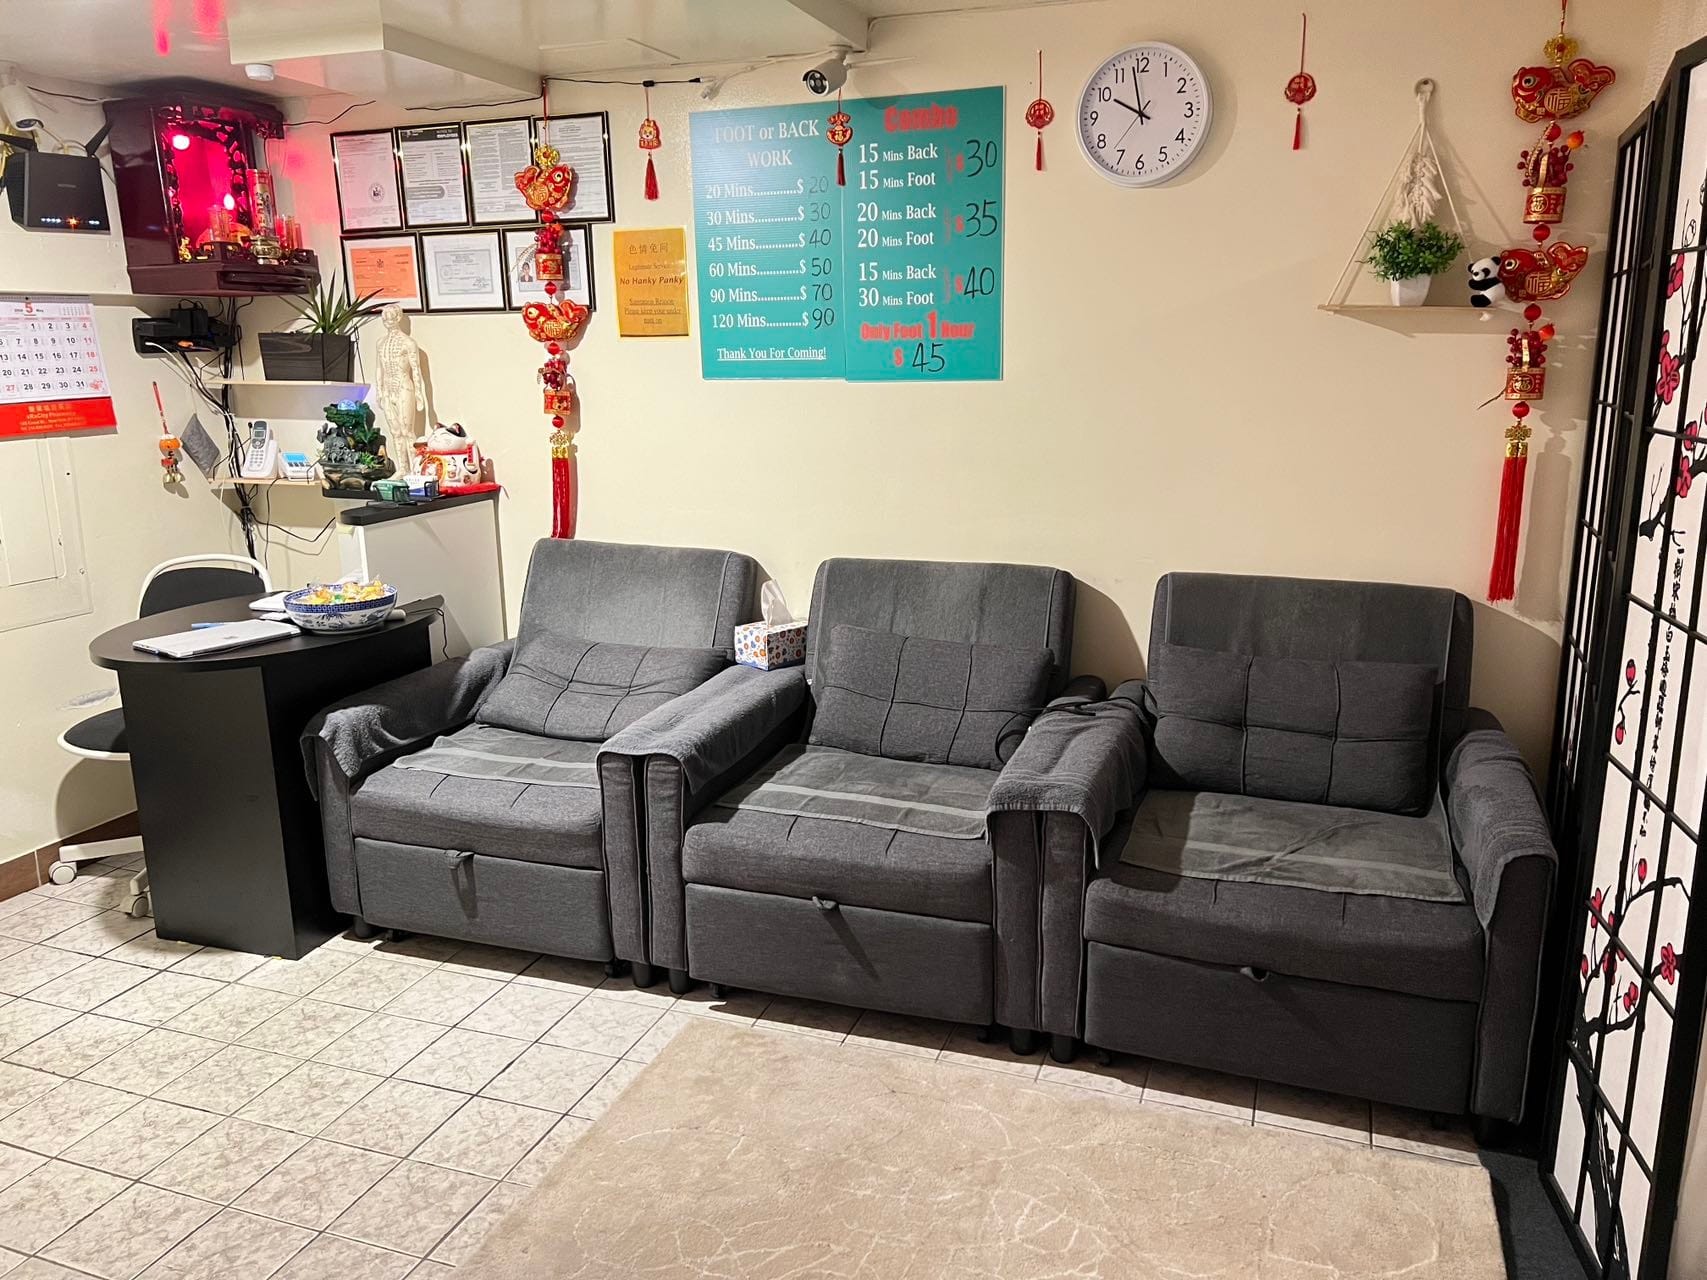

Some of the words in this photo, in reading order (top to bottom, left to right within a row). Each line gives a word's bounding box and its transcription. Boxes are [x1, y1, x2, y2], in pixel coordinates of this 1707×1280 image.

[1136, 57, 1150, 73] 12
[1163, 62, 1168, 77] 1
[1114, 67, 1125, 84] 11
[1176, 77, 1187, 93] 2
[1097, 86, 1112, 102] 10
[884, 103, 958, 133] Combo
[1090, 111, 1099, 126] 9
[1184, 102, 1194, 118] 3
[714, 125, 755, 143] FOOT
[760, 127, 774, 140] or
[779, 120, 819, 139] BACK
[1096, 133, 1107, 149] 8
[1174, 128, 1185, 143] 4
[747, 150, 793, 168] WORK
[859, 143, 878, 163] 15
[882, 151, 904, 162] Mins
[907, 143, 938, 160] Back
[966, 139, 998, 178] 30
[1116, 149, 1126, 165] 7
[1135, 154, 1145, 170] 6
[1158, 146, 1168, 162] 5
[705, 185, 720, 199] 20
[809, 176, 829, 194] 20
[859, 170, 879, 190] 15
[883, 177, 904, 188] Mins
[907, 172, 936, 187] Foot
[706, 211, 722, 225] 30
[810, 202, 831, 222] 30
[857, 202, 878, 222] 20
[881, 209, 903, 220] Mins
[906, 203, 937, 220] Back
[966, 199, 998, 238] 35
[707, 237, 723, 251] 45
[809, 229, 832, 249] 40
[857, 228, 878, 248] 20
[882, 236, 903, 247] Mins
[906, 231, 934, 245] Foot
[709, 262, 724, 277] 60
[811, 257, 832, 277] 50
[859, 262, 878, 281] 15
[882, 270, 903, 280] Mins
[906, 264, 937, 280] Back
[620, 277, 630, 285] No
[632, 277, 657, 285] Hanky
[659, 275, 683, 285] Panky
[964, 266, 995, 299] 40
[710, 288, 725, 303] 90
[812, 283, 833, 301] 70
[859, 287, 879, 307] 30
[882, 295, 903, 306] Mins
[906, 291, 934, 305] Foot
[24, 302, 33, 314] 5
[712, 314, 734, 328] 120
[812, 308, 835, 330] 90
[861, 323, 890, 341] Only
[893, 322, 923, 340] Foot
[927, 310, 938, 339] 1
[940, 320, 975, 339] Hour
[717, 347, 746, 360] Thank
[748, 347, 767, 360] You
[769, 347, 785, 360] For
[787, 346, 827, 360] Coming!
[912, 342, 945, 373] 45
[24, 383, 33, 391] 28
[41, 382, 51, 390] 29
[58, 381, 69, 389] 30
